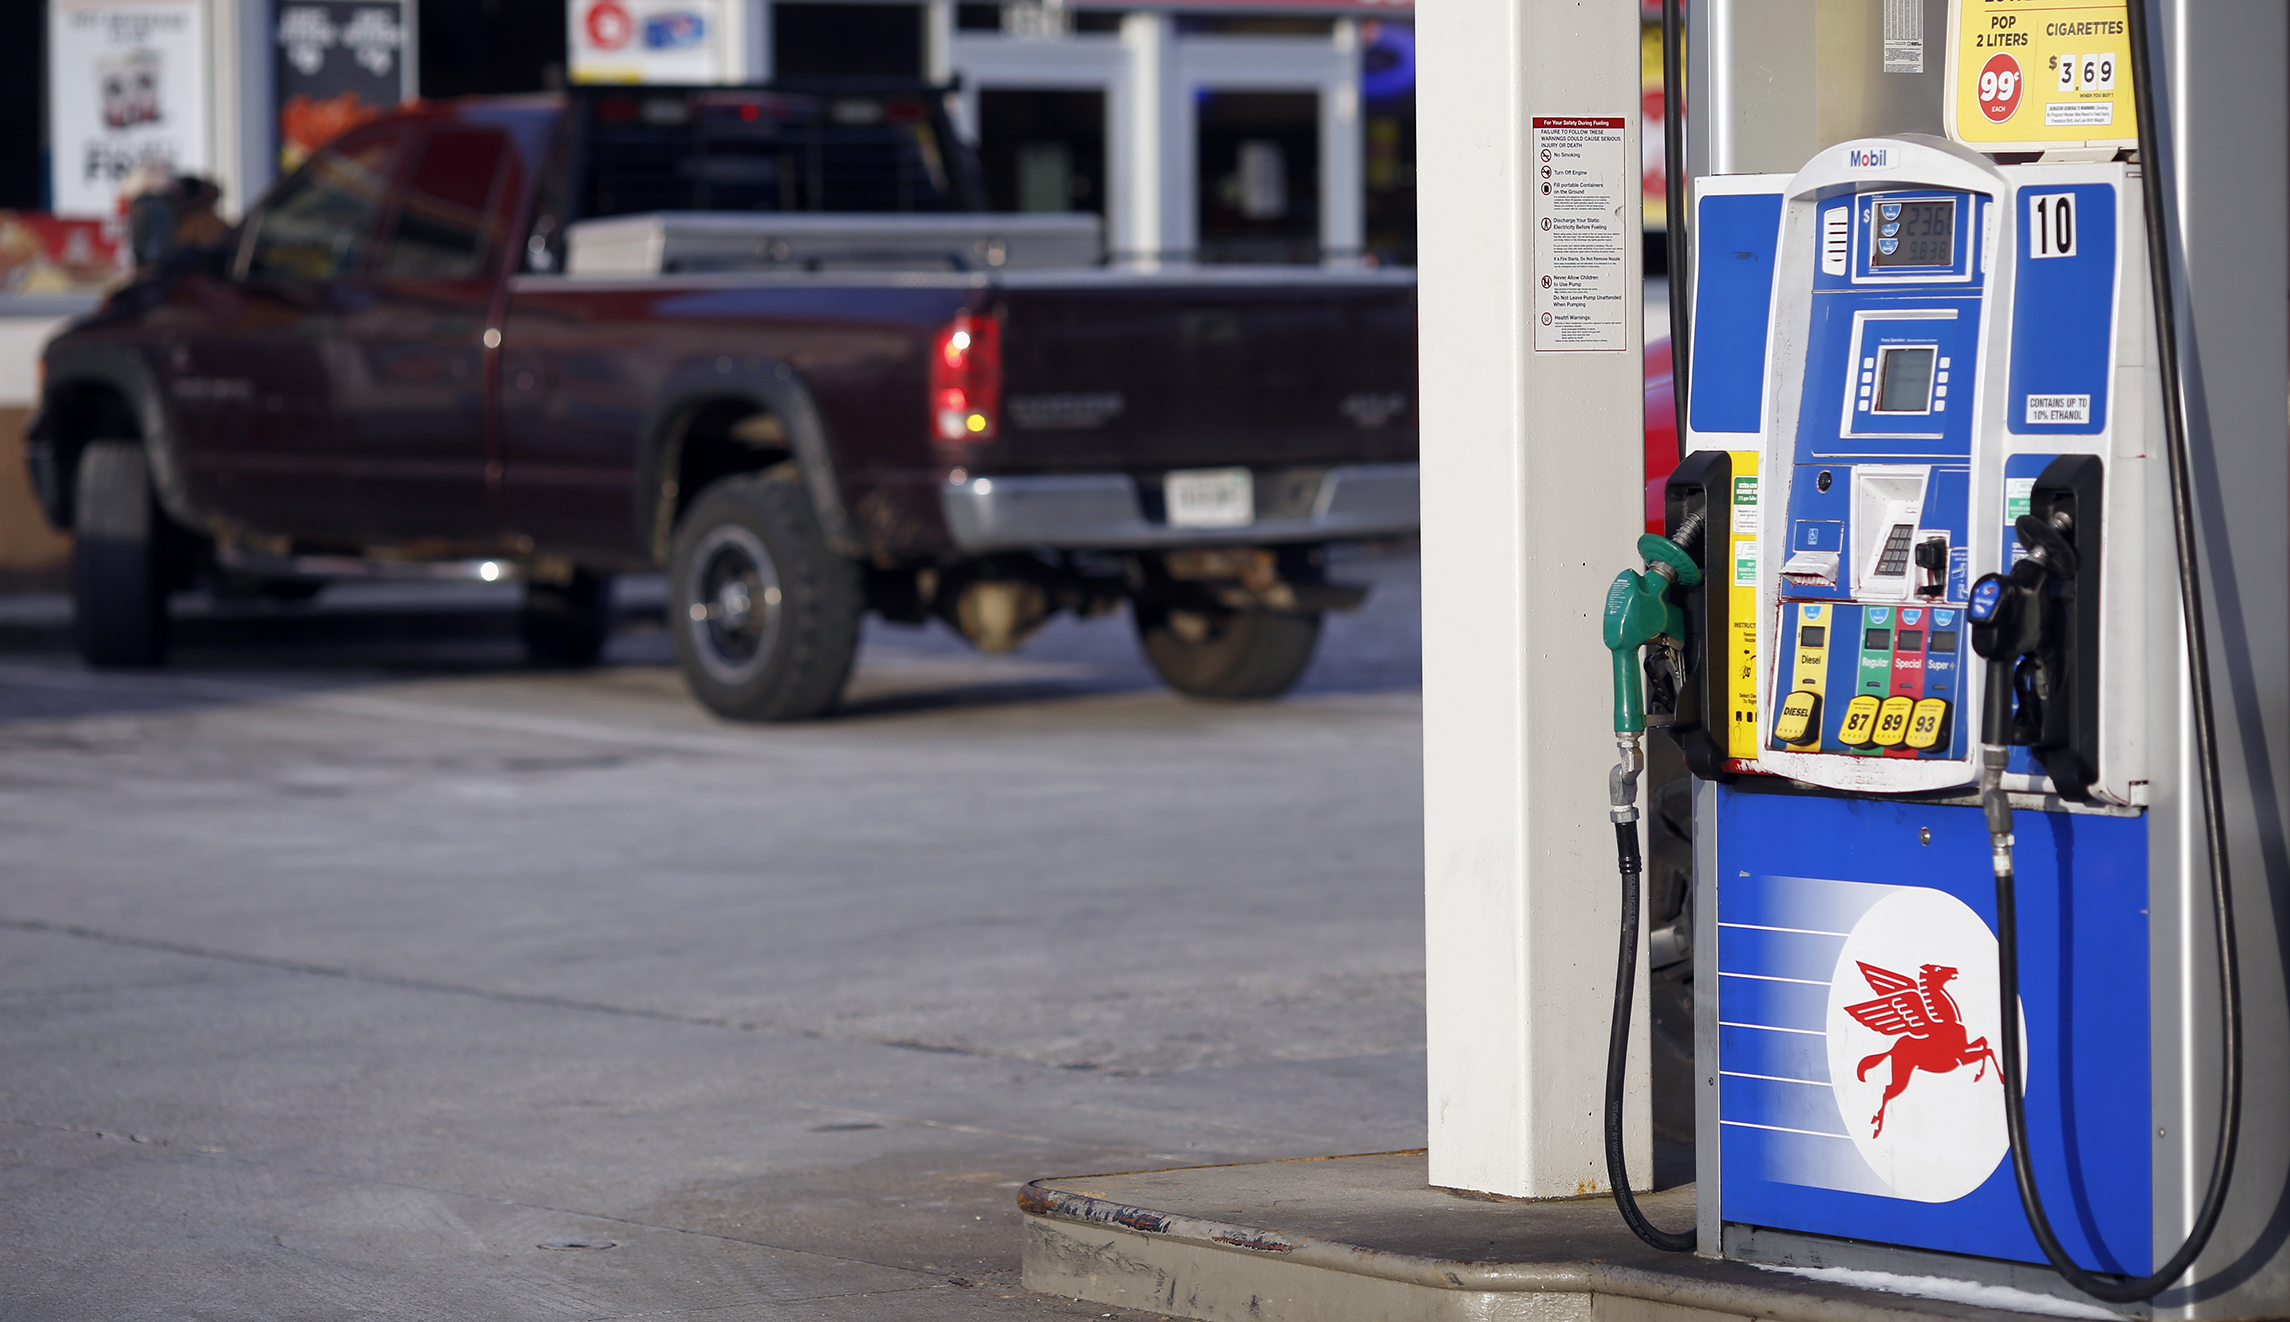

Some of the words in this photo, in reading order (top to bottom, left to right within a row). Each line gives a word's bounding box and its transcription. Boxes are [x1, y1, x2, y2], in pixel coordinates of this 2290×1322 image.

[1991, 16, 2016, 29] POP
[2046, 21, 2123, 36] CIGARETTES
[1977, 34, 1984, 47] 2
[1986, 33, 2028, 47] LITERS
[1991, 105, 2006, 113] EACH
[1552, 119, 1562, 127] Your
[1563, 119, 1577, 127] Safety
[1578, 119, 1592, 127] During
[1593, 119, 1609, 127] Fueling
[1850, 150, 1886, 167] Mobil
[1863, 208, 1871, 223] $
[2038, 197, 2072, 254] 10
[2030, 398, 2064, 408] CONTAINS
[2067, 398, 2076, 408] UP
[2079, 398, 2088, 408] TO
[2034, 410, 2048, 420] 10%
[2051, 410, 2083, 420] ETHANOL
[1802, 655, 1821, 664] Diesel
[1862, 657, 1889, 669] Regular
[1895, 658, 1922, 670] Special
[1784, 707, 1809, 717] DIESEL
[1848, 713, 1870, 731] 87
[1882, 714, 1903, 731] 89
[1915, 716, 1936, 733] 93
